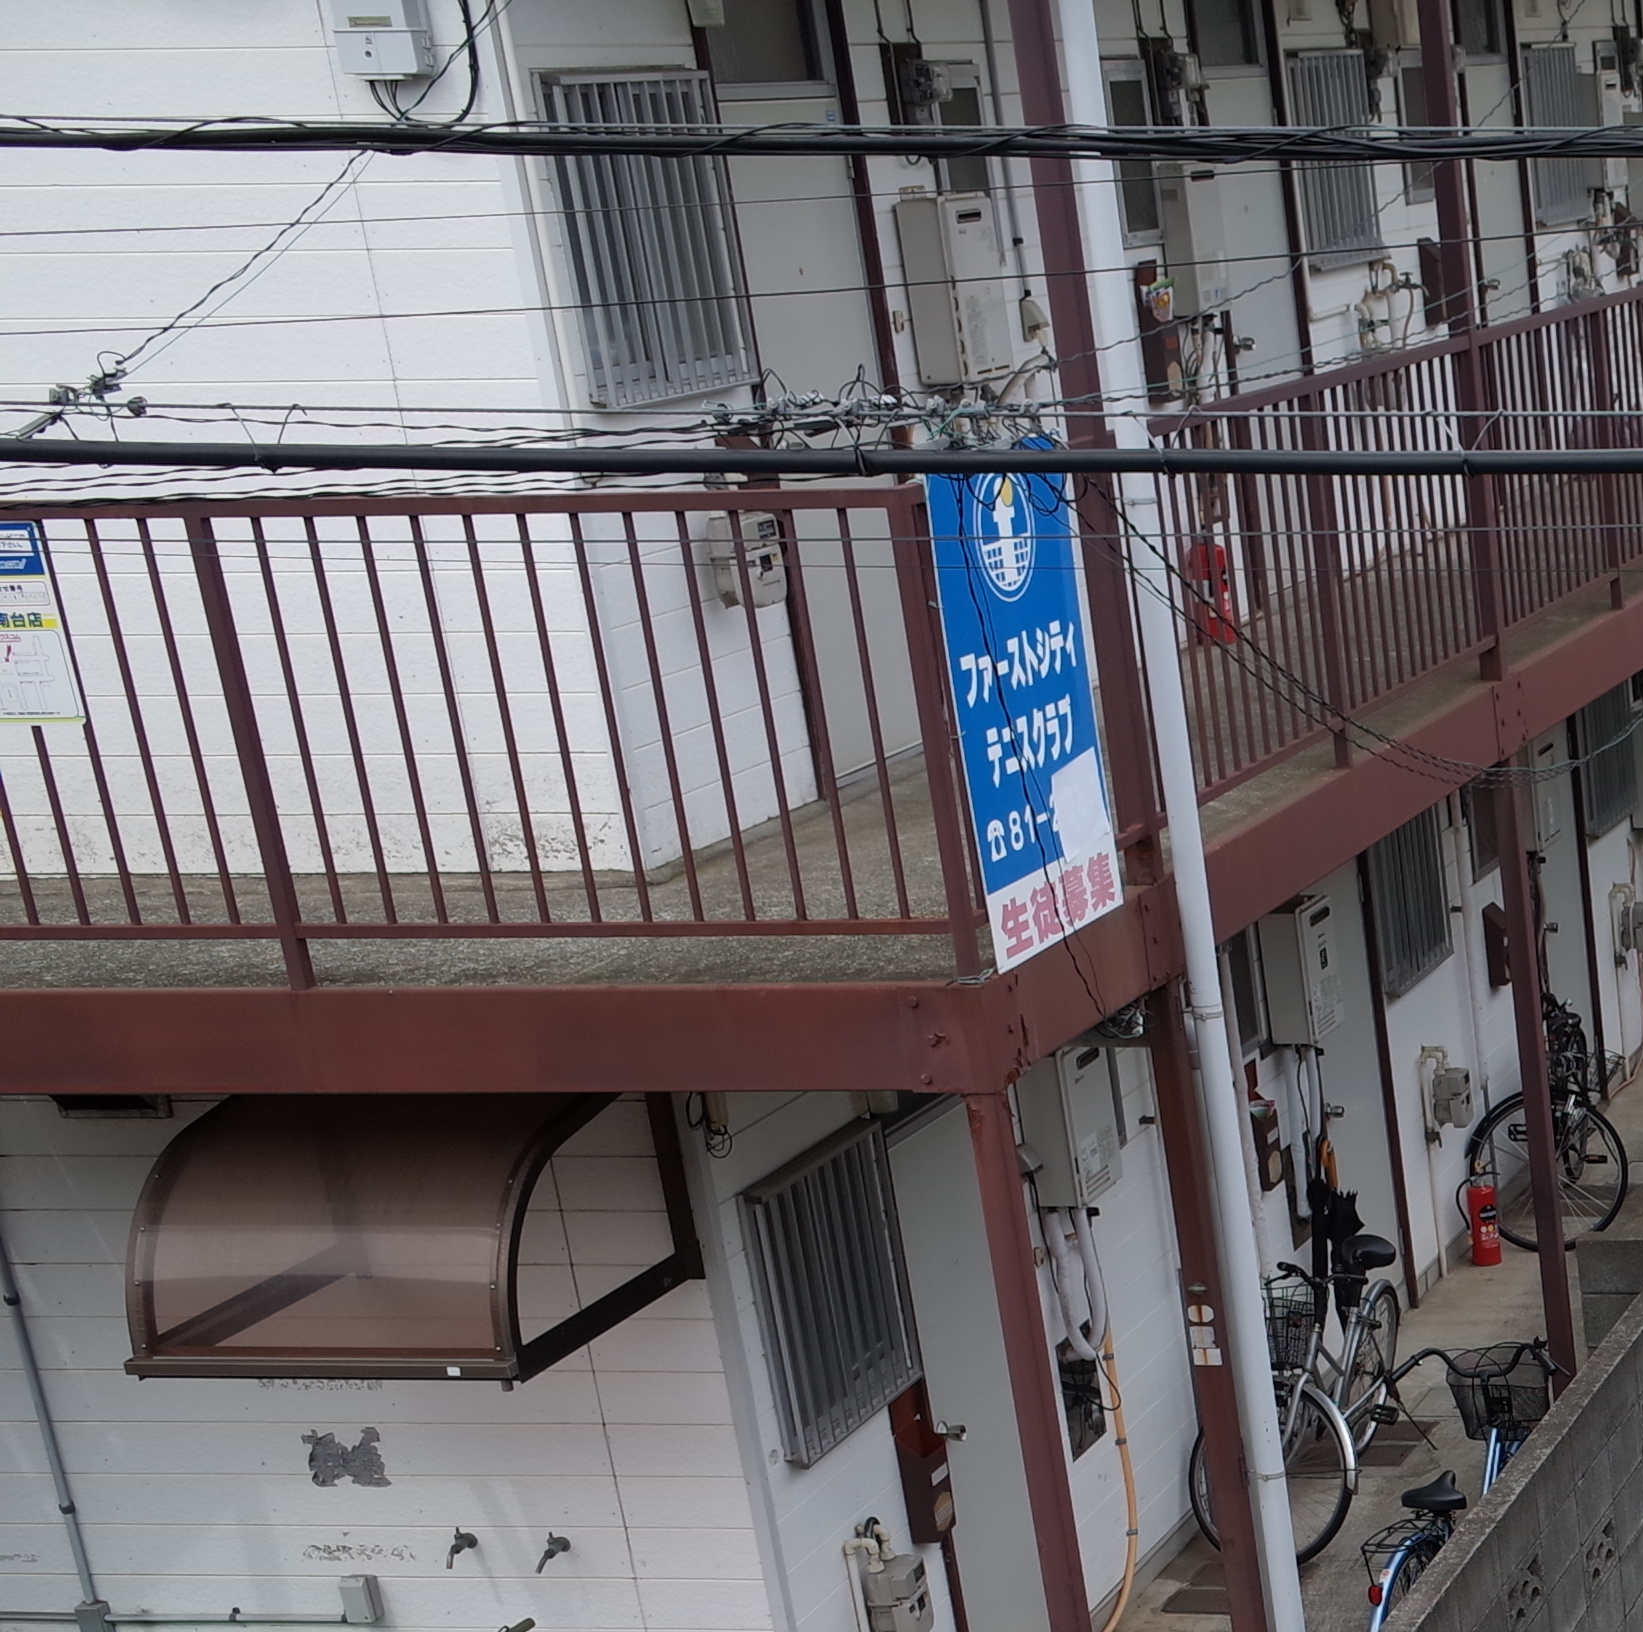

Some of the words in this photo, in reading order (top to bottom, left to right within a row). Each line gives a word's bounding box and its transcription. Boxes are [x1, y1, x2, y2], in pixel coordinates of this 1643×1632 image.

[960, 620, 1077, 708] ファーストシティ
[986, 693, 1073, 788] テニスクラブ
[1001, 852, 1116, 960] 生徒募集
